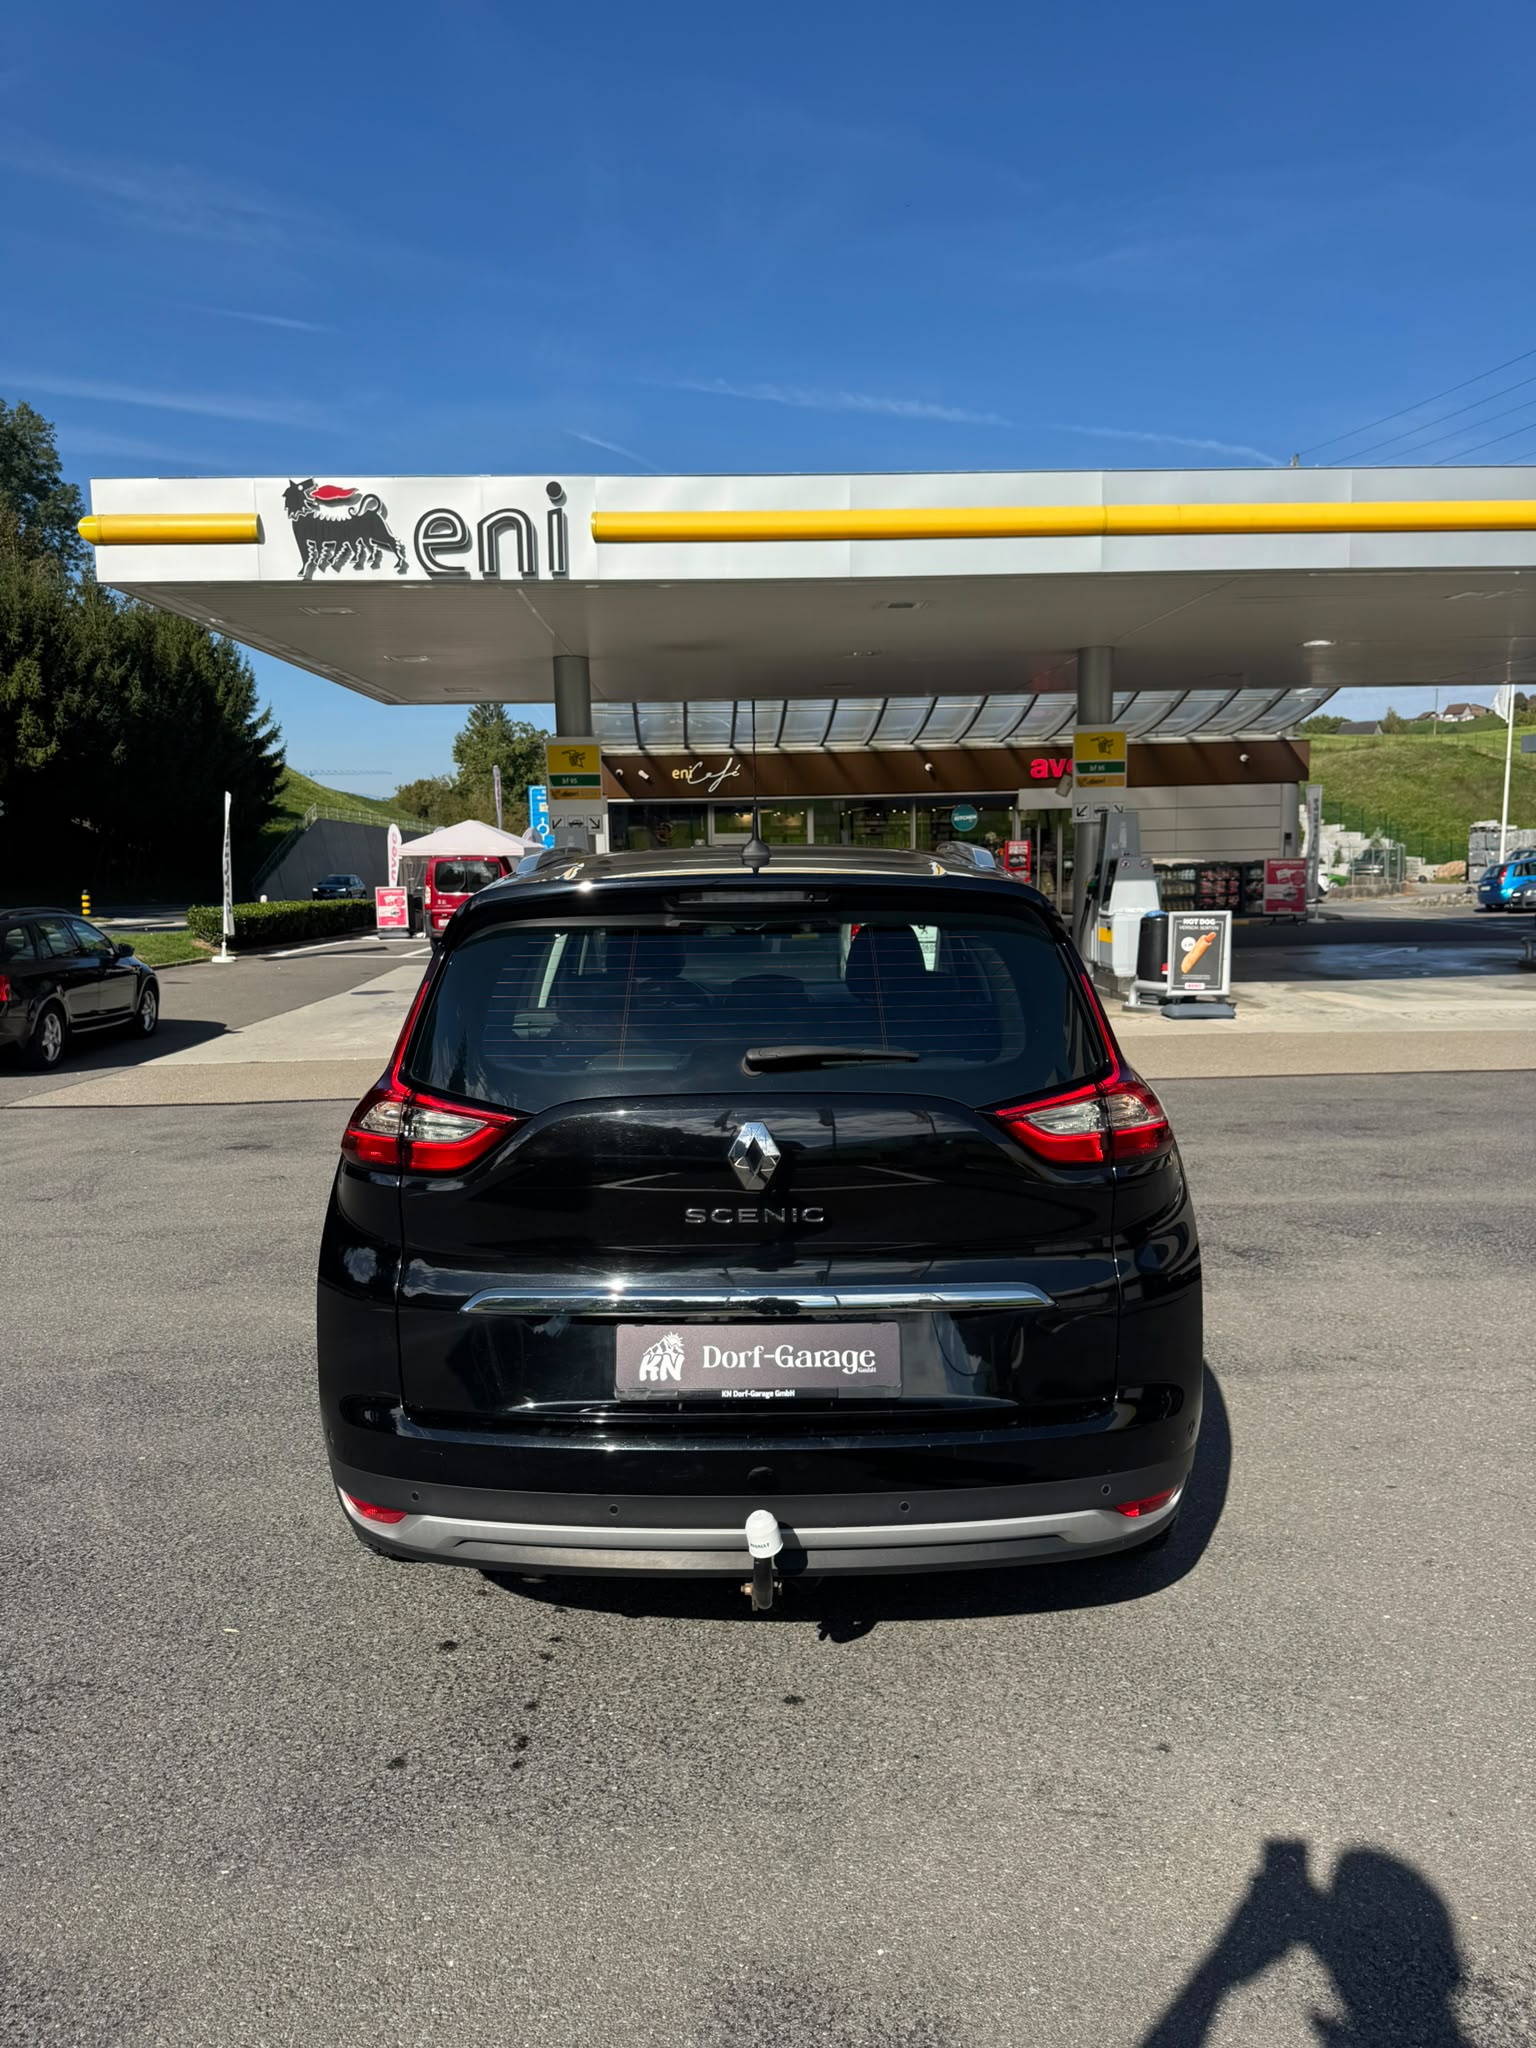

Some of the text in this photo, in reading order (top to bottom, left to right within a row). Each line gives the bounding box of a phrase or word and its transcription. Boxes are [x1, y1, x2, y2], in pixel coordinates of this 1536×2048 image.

[413, 481, 567, 577] eni
[672, 766, 692, 779] eni
[1183, 918, 1216, 926] HOT DOG
[684, 1207, 824, 1223] SCENIC
[639, 1353, 684, 1382] KN
[703, 1345, 876, 1375] Dorf-Garage
[722, 1389, 795, 1399] KN Dorf-Garage GmbH
